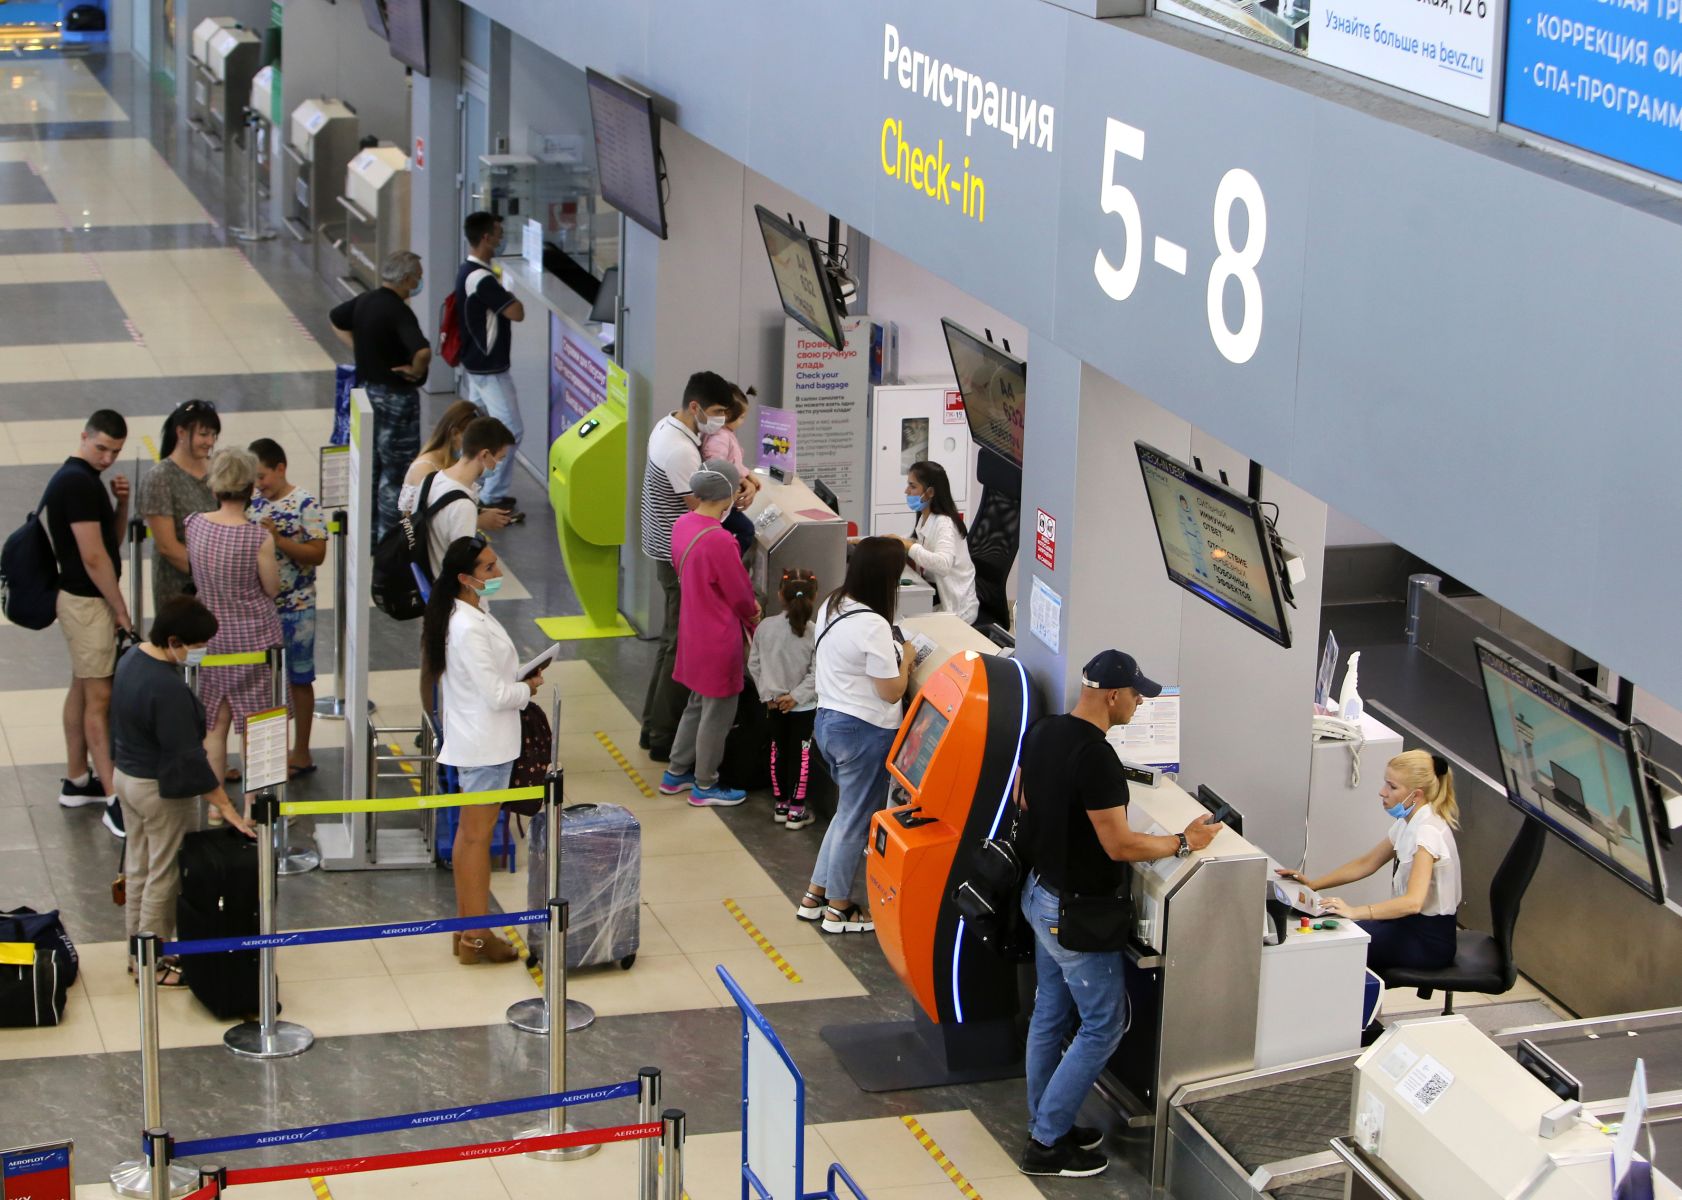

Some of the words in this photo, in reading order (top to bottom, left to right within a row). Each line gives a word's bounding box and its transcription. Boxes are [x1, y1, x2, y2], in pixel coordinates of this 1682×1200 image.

[1325, 10, 1370, 39] Узнайте
[1373, 23, 1419, 53] больше
[1422, 42, 1436, 59] на
[1439, 42, 1484, 73] bevz.ru
[1536, 12, 1649, 67] КОРРЕКЦИЯ
[883, 23, 1054, 152] Регистрация
[881, 118, 985, 222] Check-in
[797, 351, 821, 359] свою
[822, 350, 857, 359] ручную
[816, 382, 849, 390] baggage
[821, 372, 839, 380] your
[1200, 510, 1236, 534] ИММУННЫЙ
[1213, 564, 1250, 590] ПОБОЧНЫХ
[1216, 575, 1253, 601] ЭФФЕКТОВ
[241, 938, 285, 946] AEROFLOT
[381, 926, 423, 935] AEROFLOT
[256, 1133, 304, 1144] AEROFLOT
[411, 1113, 458, 1124] AEROFLOT
[562, 1090, 607, 1102] AEROFLOT
[8, 1157, 44, 1167] AEROFLOT
[304, 1164, 350, 1174] AEROFLOT
[460, 1146, 506, 1157] AEROFLOT
[614, 1126, 661, 1137] AEROFLOT
